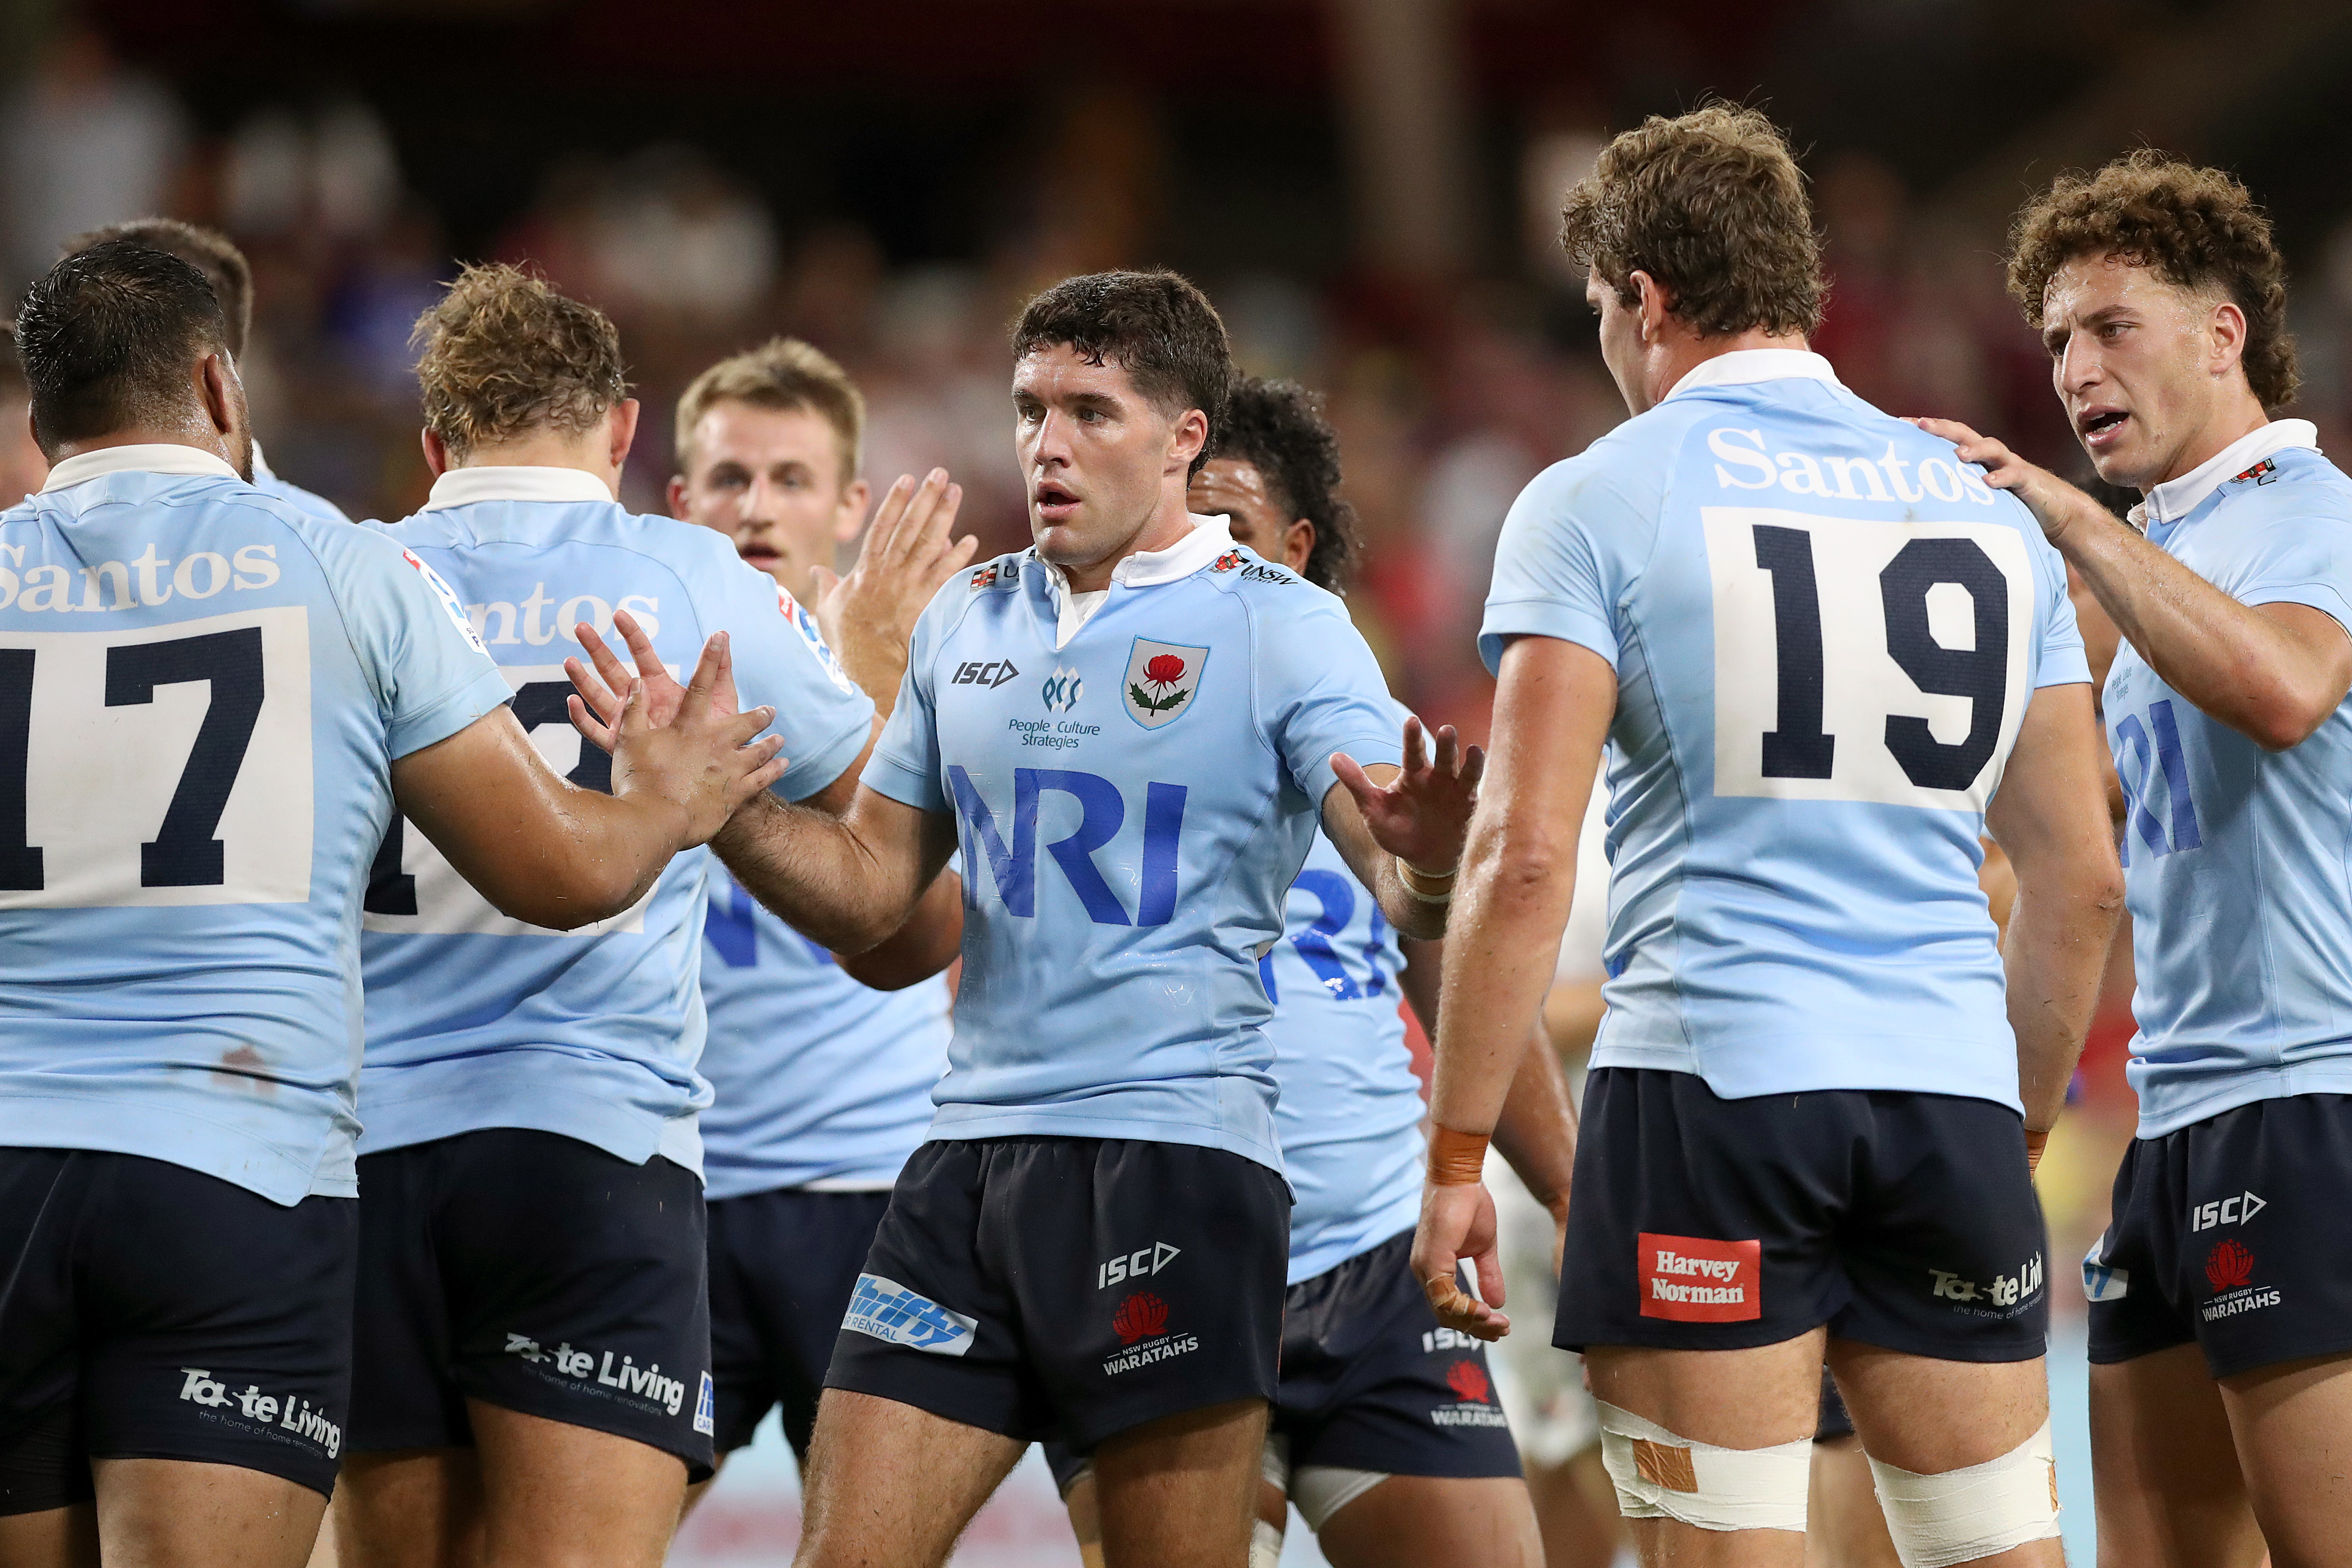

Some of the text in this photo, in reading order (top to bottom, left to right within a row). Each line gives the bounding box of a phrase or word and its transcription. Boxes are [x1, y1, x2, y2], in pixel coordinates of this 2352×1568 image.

[1707, 428, 1995, 506] Santos
[1241, 564, 1299, 585] UNSW
[464, 582, 660, 646] ntos
[951, 662, 1001, 685] ISC
[1752, 524, 2008, 791] 19
[1008, 719, 1050, 734] People
[1057, 720, 1100, 736] Culture
[1021, 733, 1080, 751] Strategies
[2115, 699, 2202, 869] RI
[947, 765, 1188, 927] NRI
[1258, 868, 1386, 1002] RI
[2192, 1196, 2241, 1233] ISC
[1098, 1247, 1152, 1290] ISC
[1656, 1250, 1740, 1283] Harvey
[1651, 1277, 1745, 1304] Norman
[2202, 1290, 2281, 1323] WARATAHS
[2214, 1287, 2252, 1304] NSW RUGBY
[851, 1318, 898, 1342] RENTAL
[1973, 1308, 2004, 1320] home
[2006, 1309, 2014, 1319] of
[1103, 1336, 1199, 1376] WARATAHS
[1122, 1336, 1170, 1356] NSW RUGBY
[569, 1382, 582, 1392] of
[582, 1384, 612, 1400] home
[597, 1350, 685, 1416] Living
[199, 1409, 217, 1422] the
[220, 1414, 251, 1432] home
[253, 1425, 266, 1435] of
[266, 1428, 291, 1445] home
[280, 1395, 341, 1460] Living
